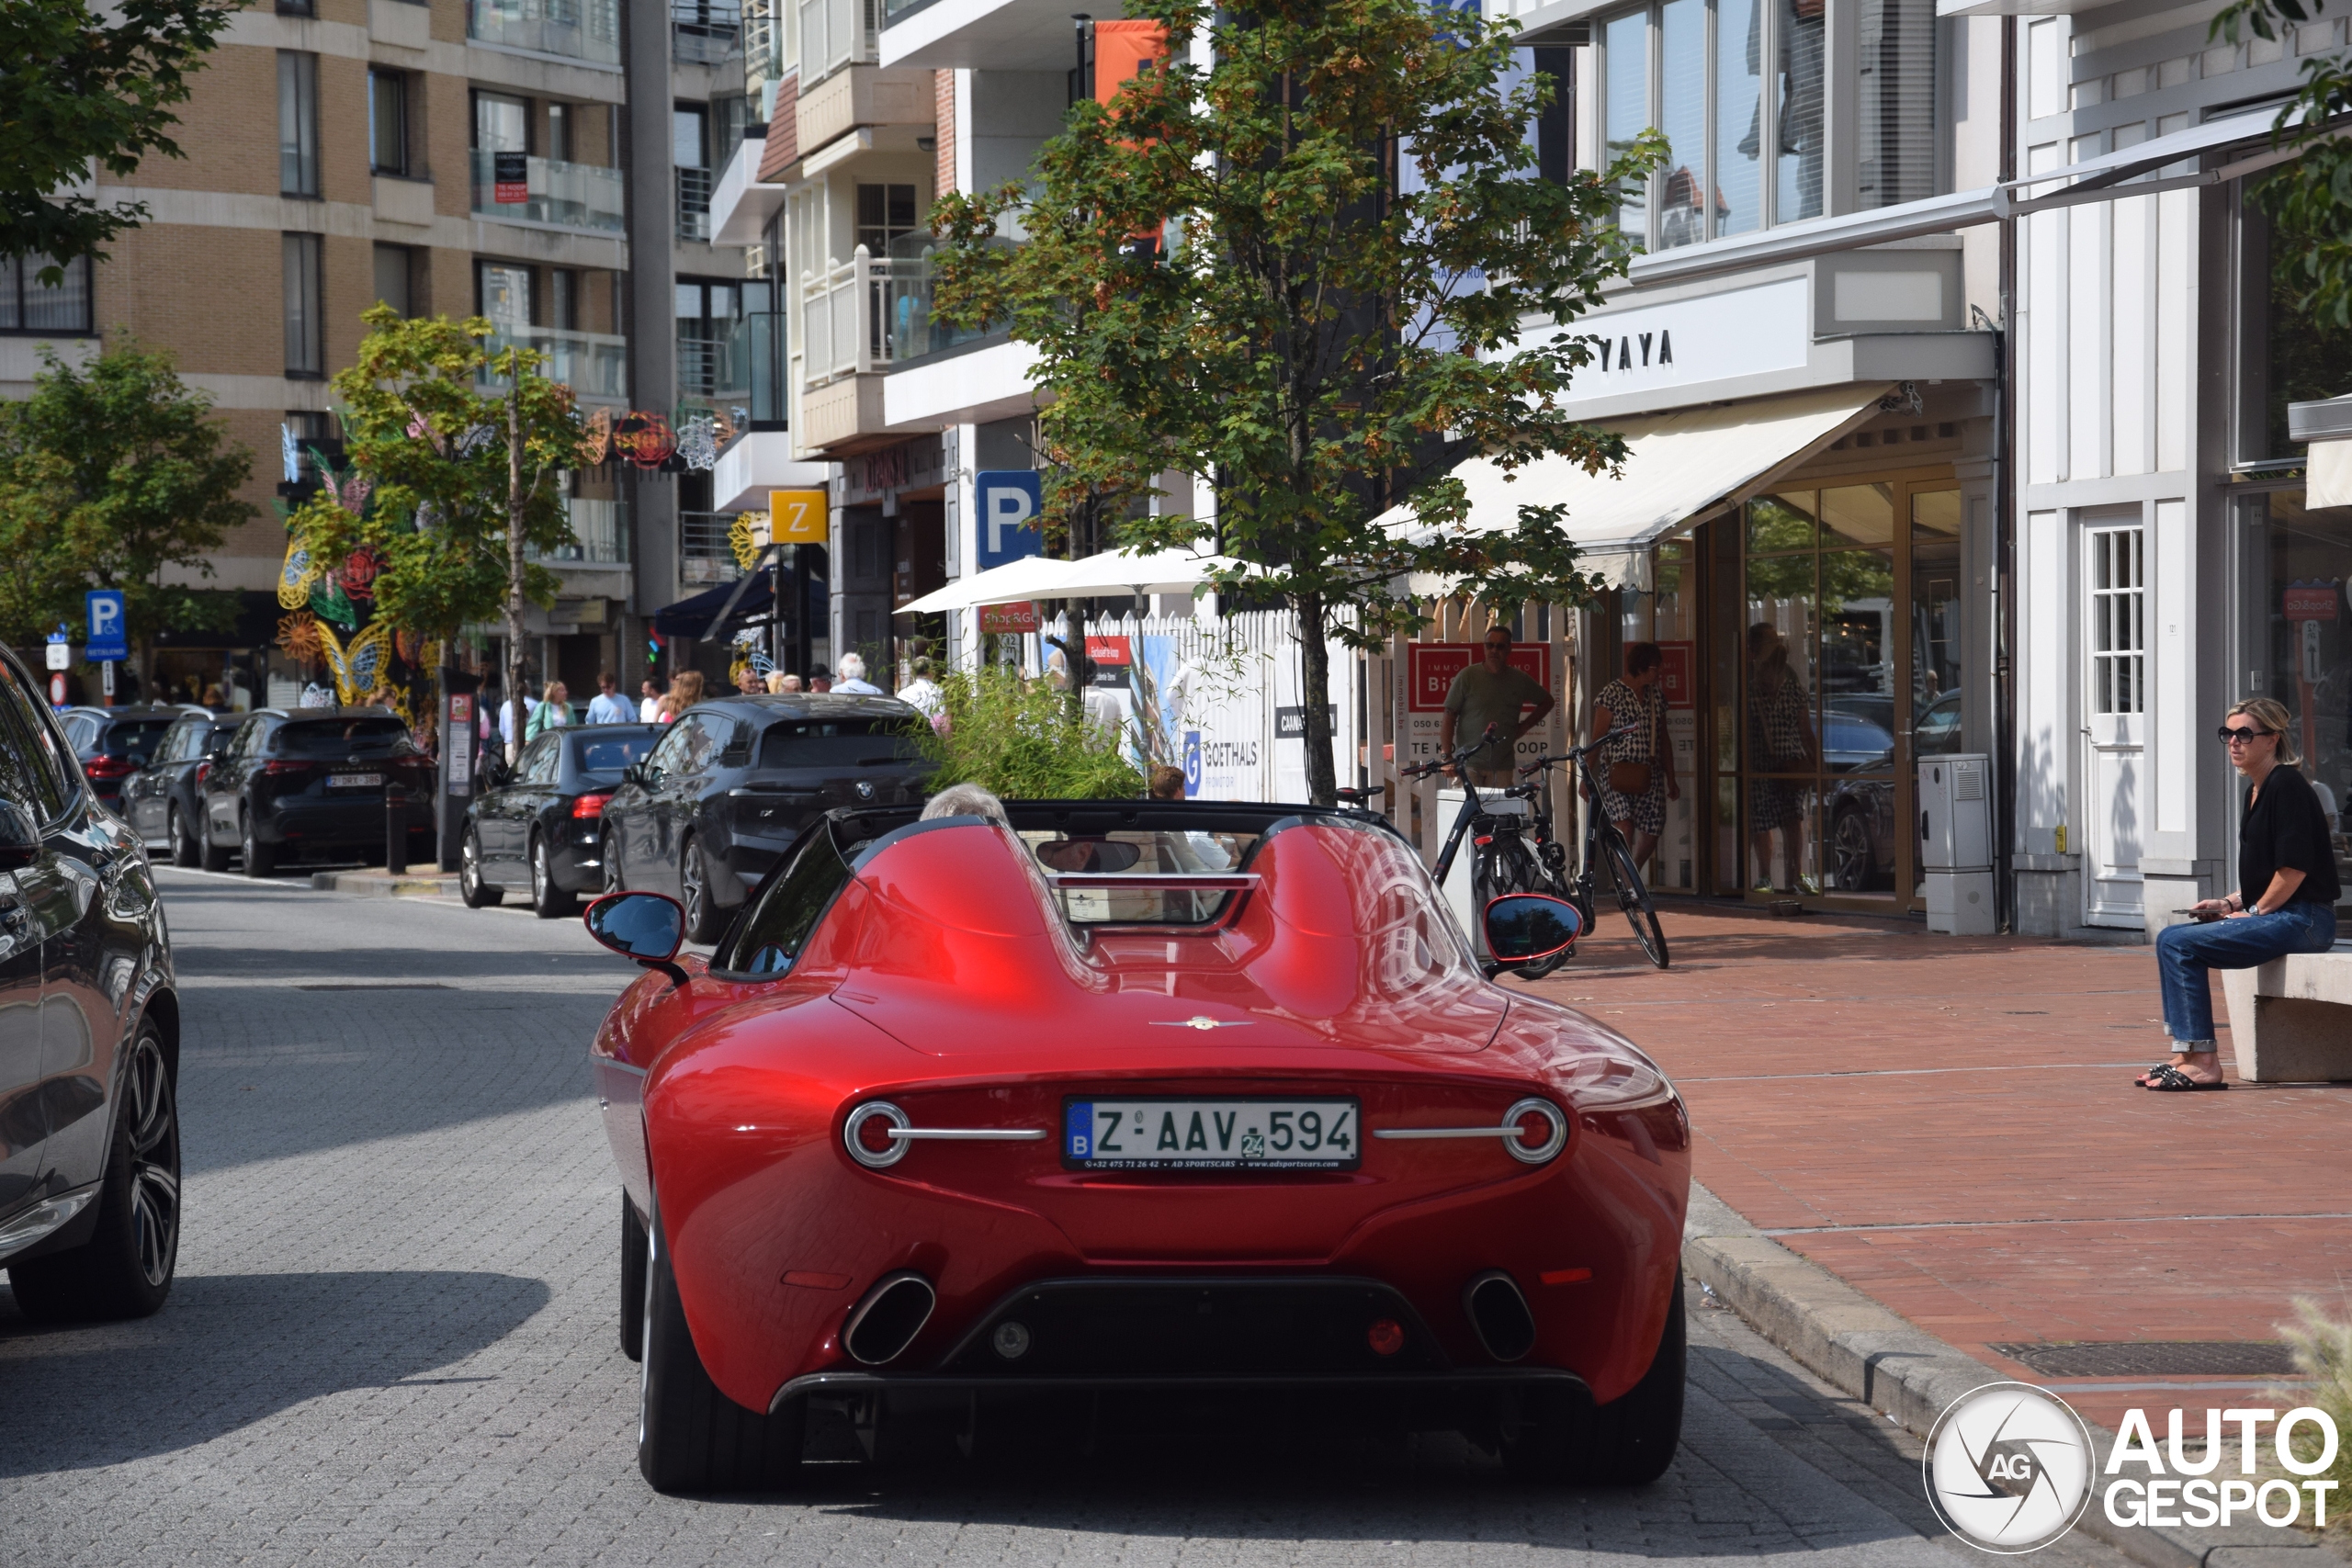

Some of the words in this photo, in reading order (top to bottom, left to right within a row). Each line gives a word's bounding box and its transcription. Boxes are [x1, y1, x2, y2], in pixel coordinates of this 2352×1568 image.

[1600, 329, 1673, 372] YAYA
[787, 502, 809, 533] Z
[987, 487, 1032, 552] P
[92, 598, 119, 636] P
[1205, 741, 1257, 768] GOETHALS
[1411, 742, 1429, 754] TE
[1517, 742, 1548, 753] OOP
[1205, 777, 1234, 788] PROMOTOR
[1073, 1136, 1088, 1155] B
[1248, 1161, 1339, 1169] www.adsportscars.com
